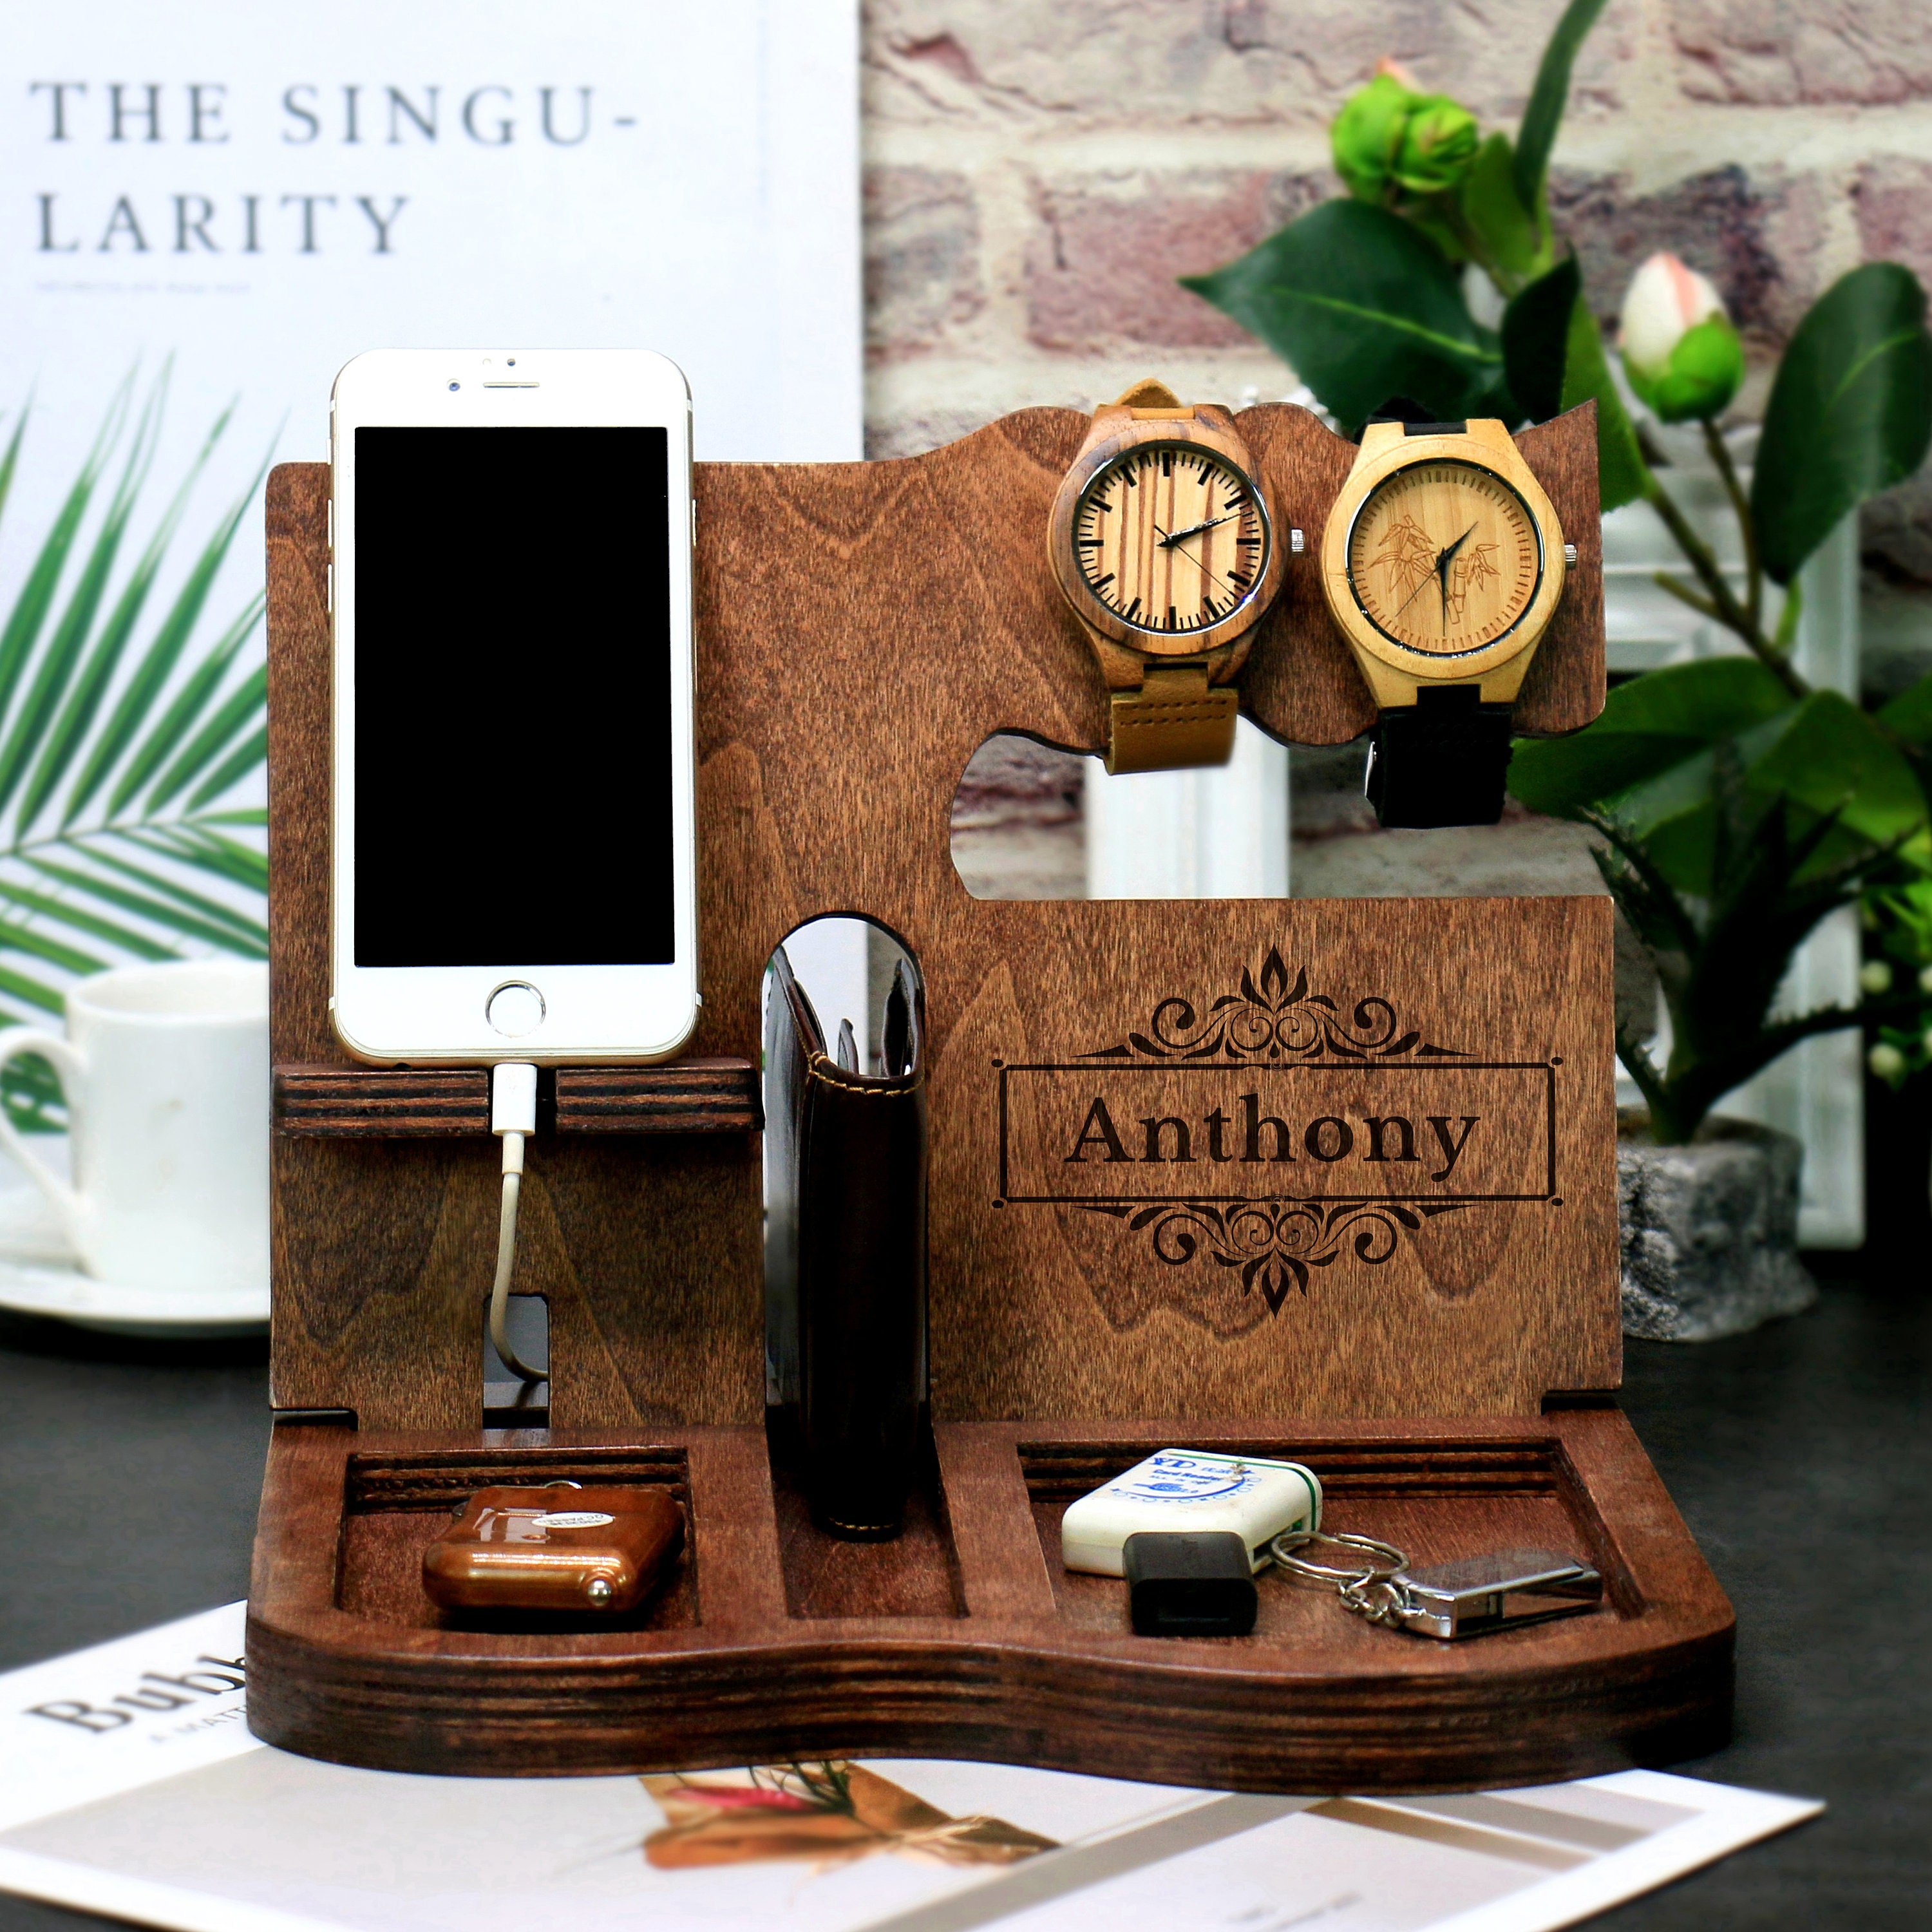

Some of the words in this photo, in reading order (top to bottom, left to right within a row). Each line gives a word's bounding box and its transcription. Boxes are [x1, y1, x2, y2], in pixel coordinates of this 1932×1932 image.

[30, 82, 229, 143] THE
[281, 85, 636, 146] SINGU-
[37, 193, 408, 254] LARITY
[1064, 1093, 1481, 1182] Anthony
